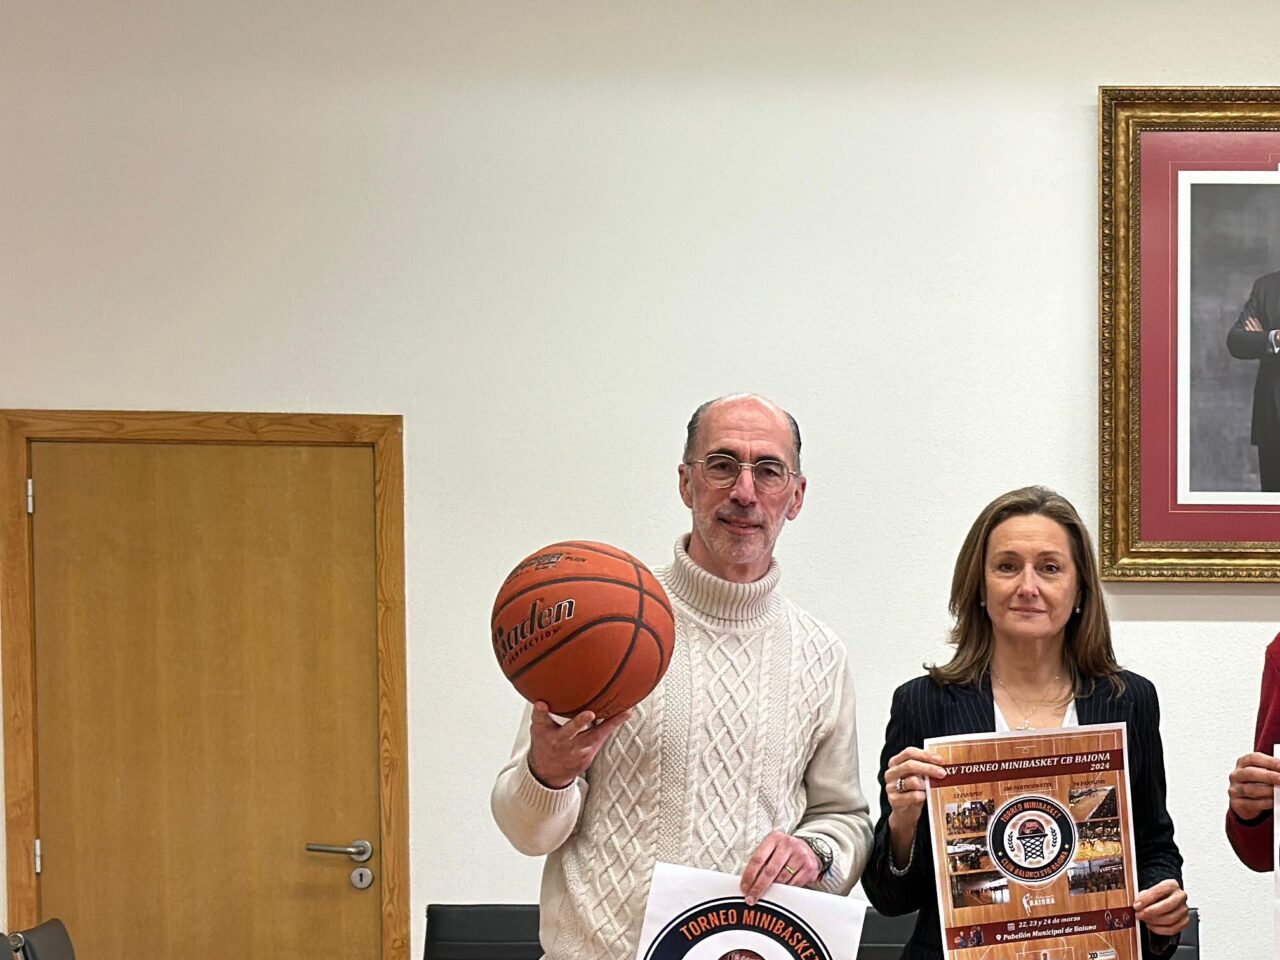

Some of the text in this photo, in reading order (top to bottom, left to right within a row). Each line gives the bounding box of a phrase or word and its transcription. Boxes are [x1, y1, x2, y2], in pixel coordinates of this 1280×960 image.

[960, 763, 999, 774] TORNEO
[1000, 757, 1059, 771] MINIBASKET
[1061, 755, 1073, 765] CB
[1074, 752, 1110, 763] BAIONA
[1089, 762, 1110, 771] 2024
[679, 908, 738, 941] TORNEO
[1032, 928, 1065, 938] Municipal
[1064, 926, 1073, 934] de
